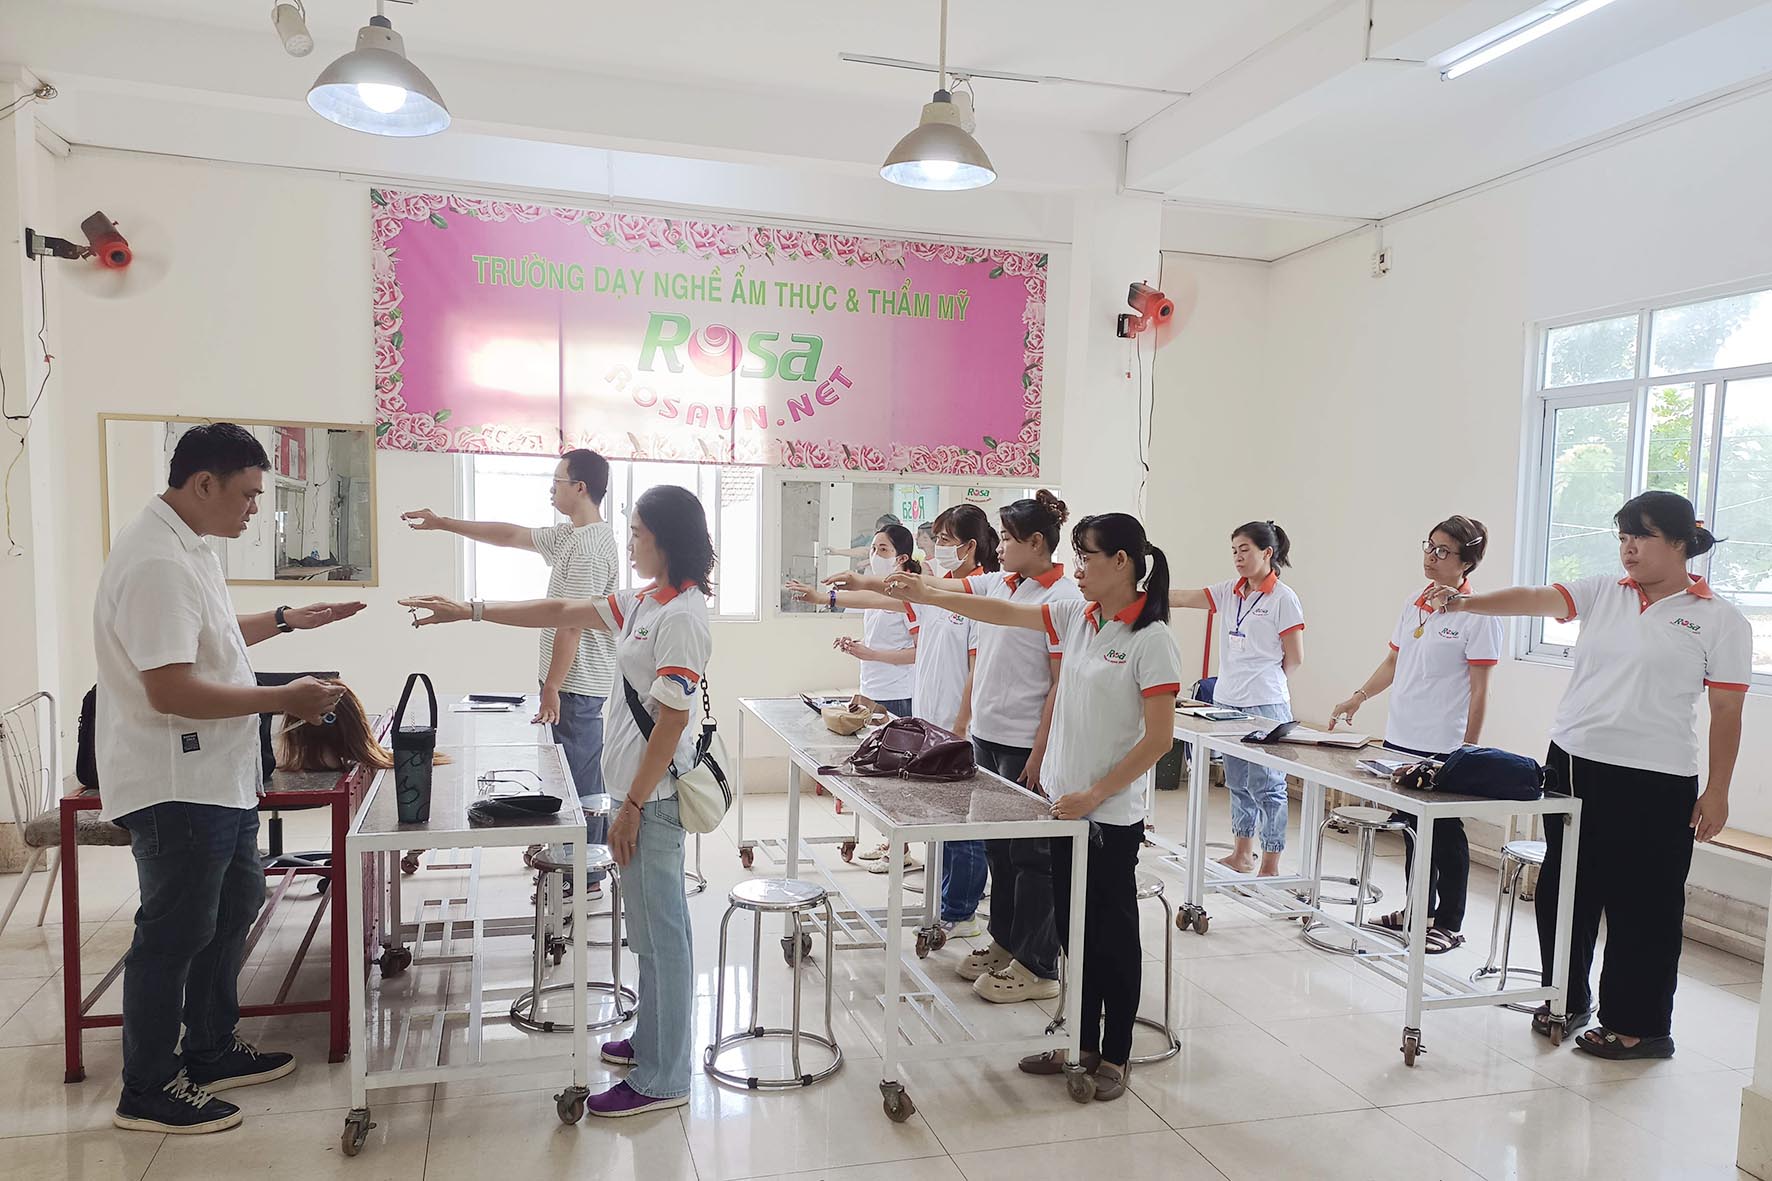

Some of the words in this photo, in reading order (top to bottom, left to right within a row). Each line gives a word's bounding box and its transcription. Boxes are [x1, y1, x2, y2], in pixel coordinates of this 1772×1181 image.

[472, 253, 585, 292] TRƯỜNG
[594, 266, 645, 300] DẠY
[654, 266, 723, 303] NGHỀ
[731, 265, 767, 306] ẨM
[774, 281, 838, 314] THỰC
[845, 287, 860, 313] &
[867, 278, 931, 319] THẨM
[937, 289, 970, 321] MỸ
[637, 311, 824, 382] Rosa
[967, 487, 990, 497] Rosa
[1673, 617, 1702, 632] Rosa
